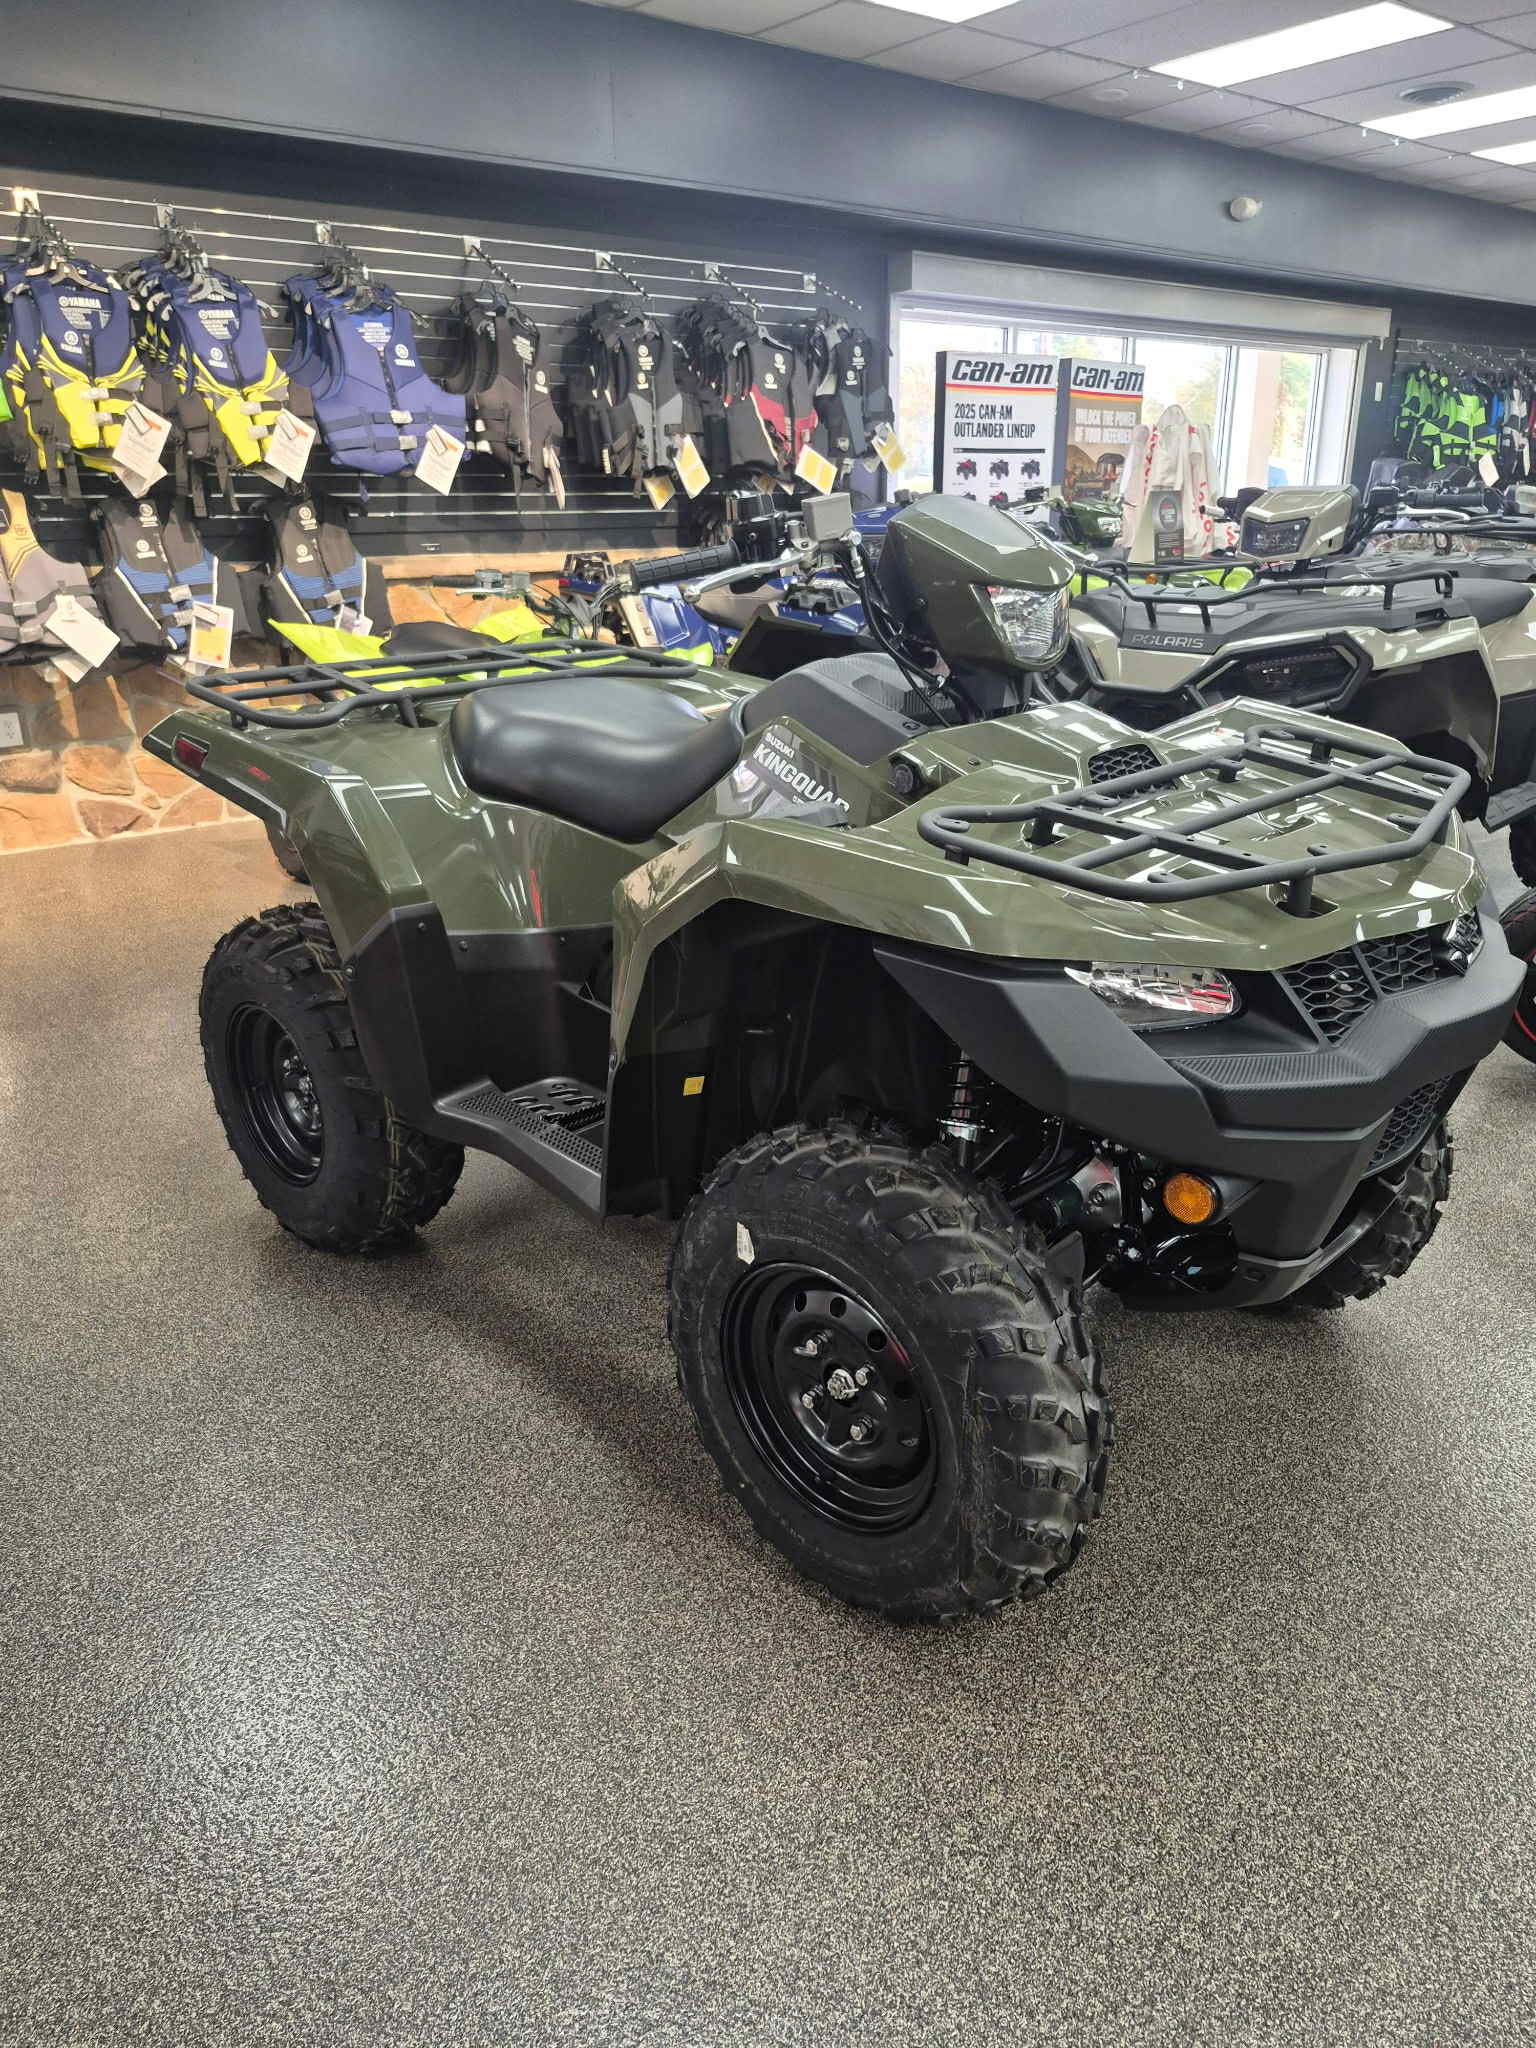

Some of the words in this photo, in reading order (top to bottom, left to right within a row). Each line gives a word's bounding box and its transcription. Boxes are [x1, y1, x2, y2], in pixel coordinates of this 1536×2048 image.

[951, 359, 1054, 385] can-am
[1072, 365, 1145, 392] can-am
[954, 403, 976, 420] 2025
[979, 404, 1013, 420] CAN-AM
[954, 422, 1004, 438] OUTLANDER
[1007, 424, 1036, 439] LINEUP
[1132, 633, 1205, 649] POLARIS
[765, 732, 795, 759] SUZUKI
